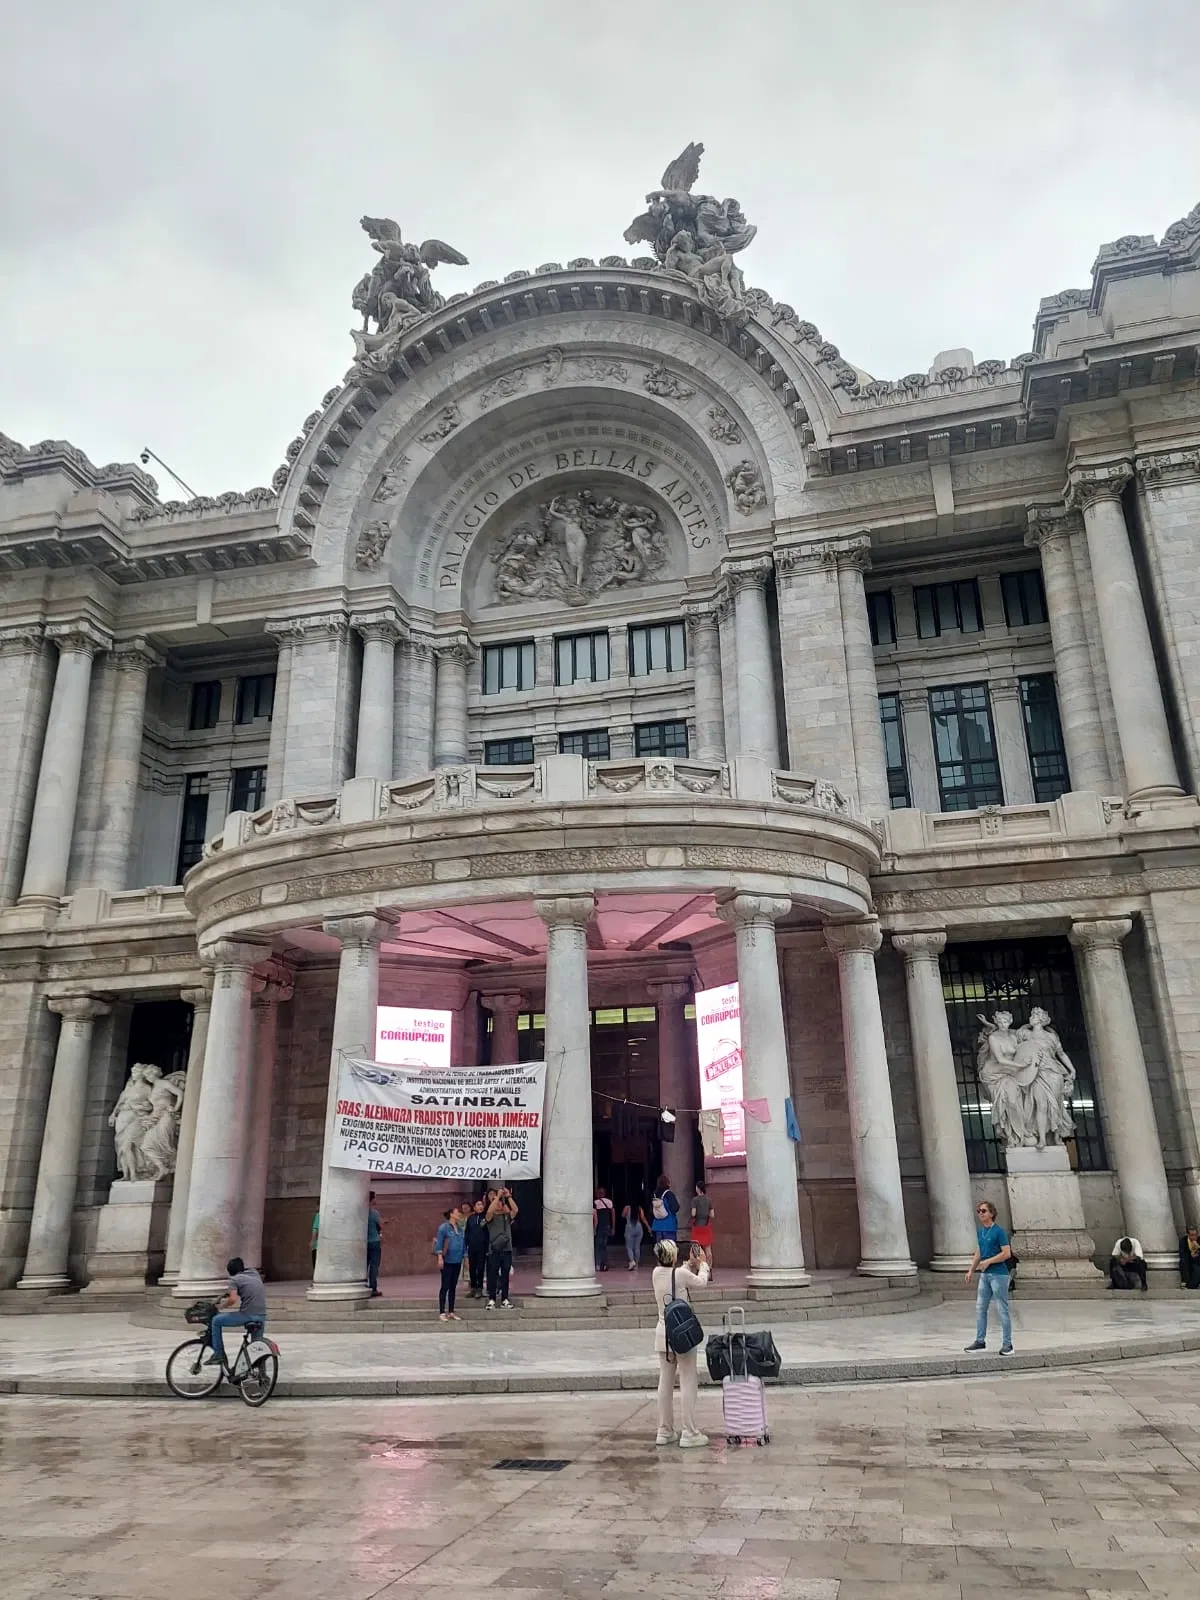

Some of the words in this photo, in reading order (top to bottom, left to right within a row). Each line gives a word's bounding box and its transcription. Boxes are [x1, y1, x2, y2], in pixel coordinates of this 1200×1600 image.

[439, 491, 499, 588] PALACIO
[507, 463, 541, 489] DE
[555, 449, 655, 477] BELLAS
[660, 479, 711, 549] ARTES
[414, 1019, 445, 1030] testigo
[407, 1076, 431, 1085] INSTITUTO
[432, 1078, 456, 1086] NACIONAL
[457, 1078, 465, 1086] DE
[465, 1078, 483, 1086] BELLAS
[494, 1086, 521, 1095] MANUALES
[410, 1094, 526, 1107] SATINBAL
[364, 1103, 412, 1123] ALEJANDRA
[414, 1109, 455, 1126] FRAUSTO
[456, 1111, 463, 1127] Y
[464, 1111, 500, 1128] LUCINA
[502, 1109, 539, 1129] JIMÉNEZ
[340, 1127, 376, 1141] NUESTROS
[376, 1132, 410, 1145] ACUERDOS
[411, 1136, 443, 1147] FIRMADOS
[443, 1138, 450, 1148] Y
[450, 1138, 486, 1149] DERECHOS
[487, 1140, 526, 1150] ADQUIRIDOS
[342, 1117, 374, 1131] EXIGIMOS
[375, 1121, 406, 1134] RESPETEN
[407, 1125, 441, 1137] NUESTRAS
[441, 1127, 487, 1139] CONDICIONES
[488, 1129, 497, 1139] DE
[499, 1129, 529, 1140] TRABAJO,
[343, 1138, 389, 1154] ¡PAGO
[392, 1143, 466, 1160] INMEDIATO
[470, 1149, 507, 1161] ROPA
[510, 1150, 529, 1162] DE
[367, 1158, 432, 1175] TRABAJO
[435, 1165, 502, 1179] 2023/2024!
